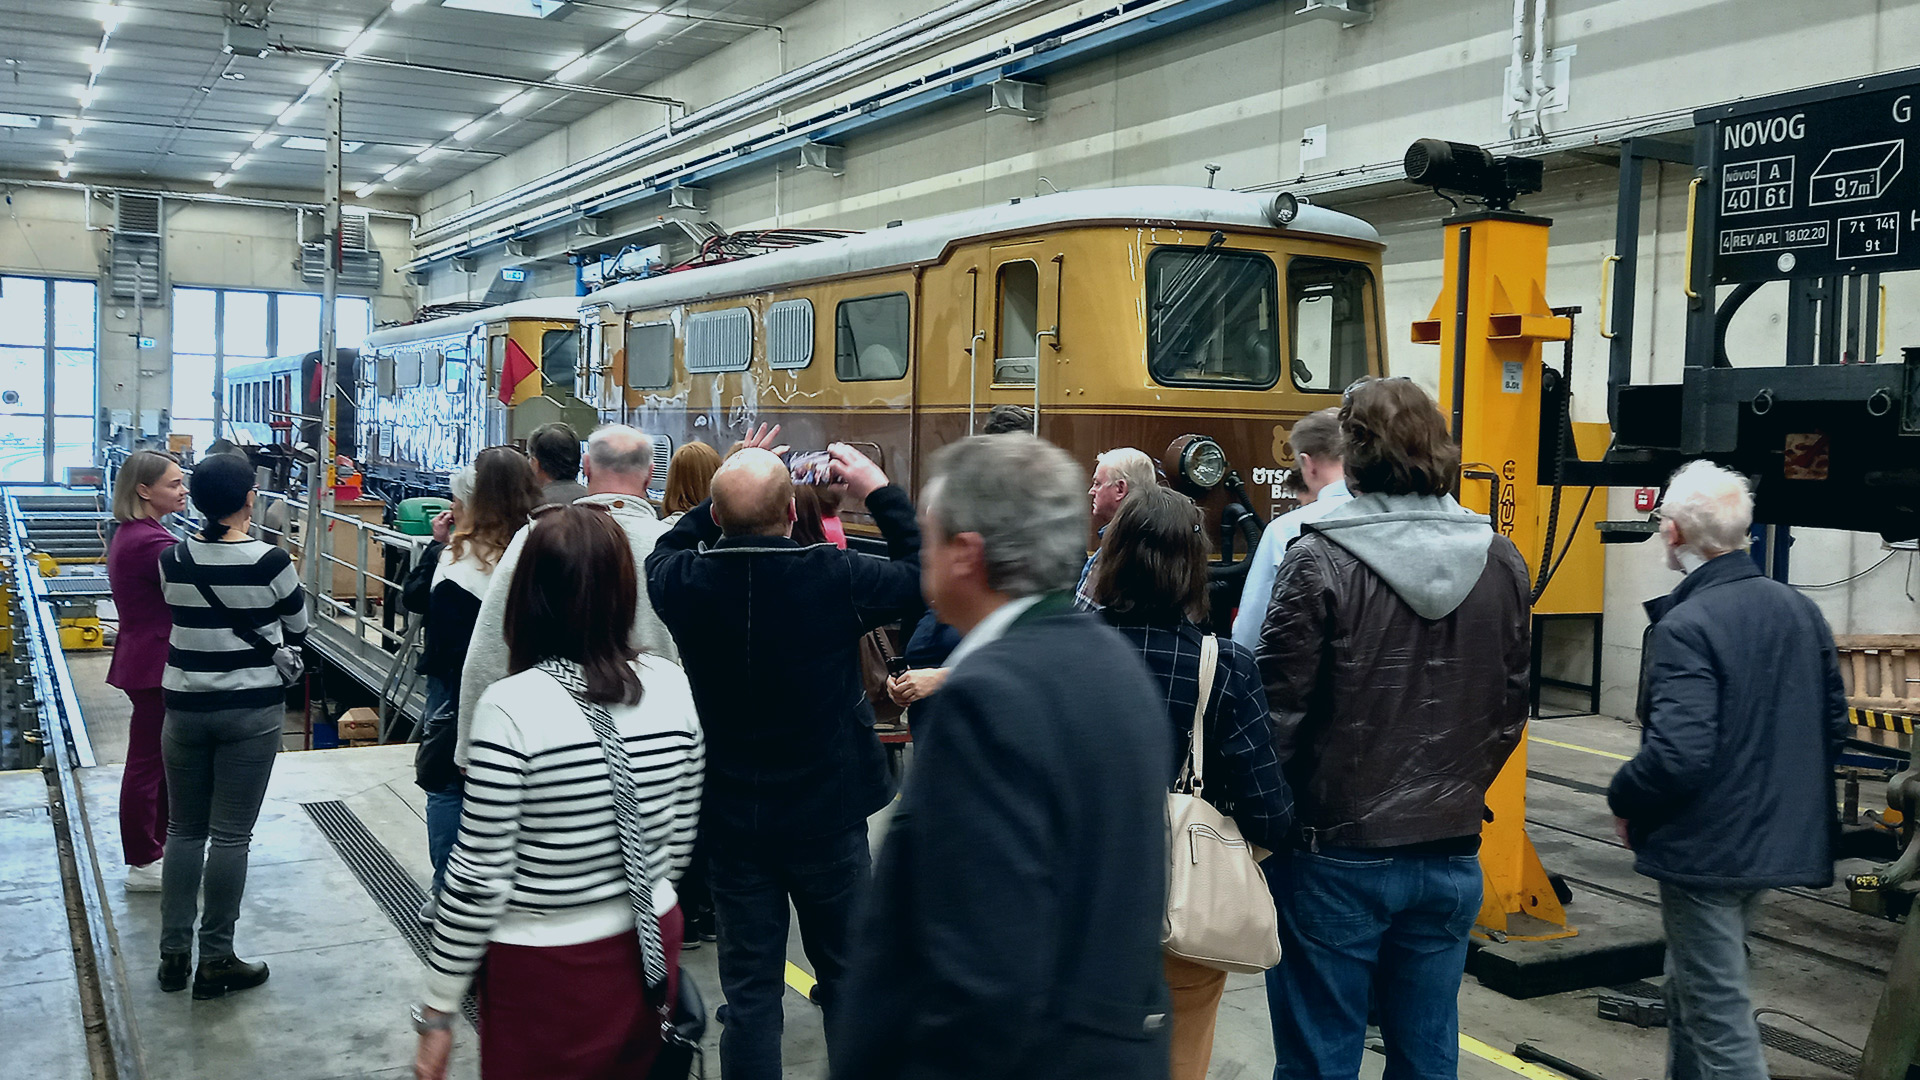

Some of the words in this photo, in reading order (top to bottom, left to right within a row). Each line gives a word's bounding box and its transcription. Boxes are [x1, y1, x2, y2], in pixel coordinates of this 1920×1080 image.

[1769, 163, 1780, 179] A
[1727, 189, 1750, 209] 40
[1876, 217, 1895, 230] 14t
[1733, 234, 1754, 247] REV
[1756, 232, 1779, 246] APL
[1500, 484, 1515, 537] AUT
